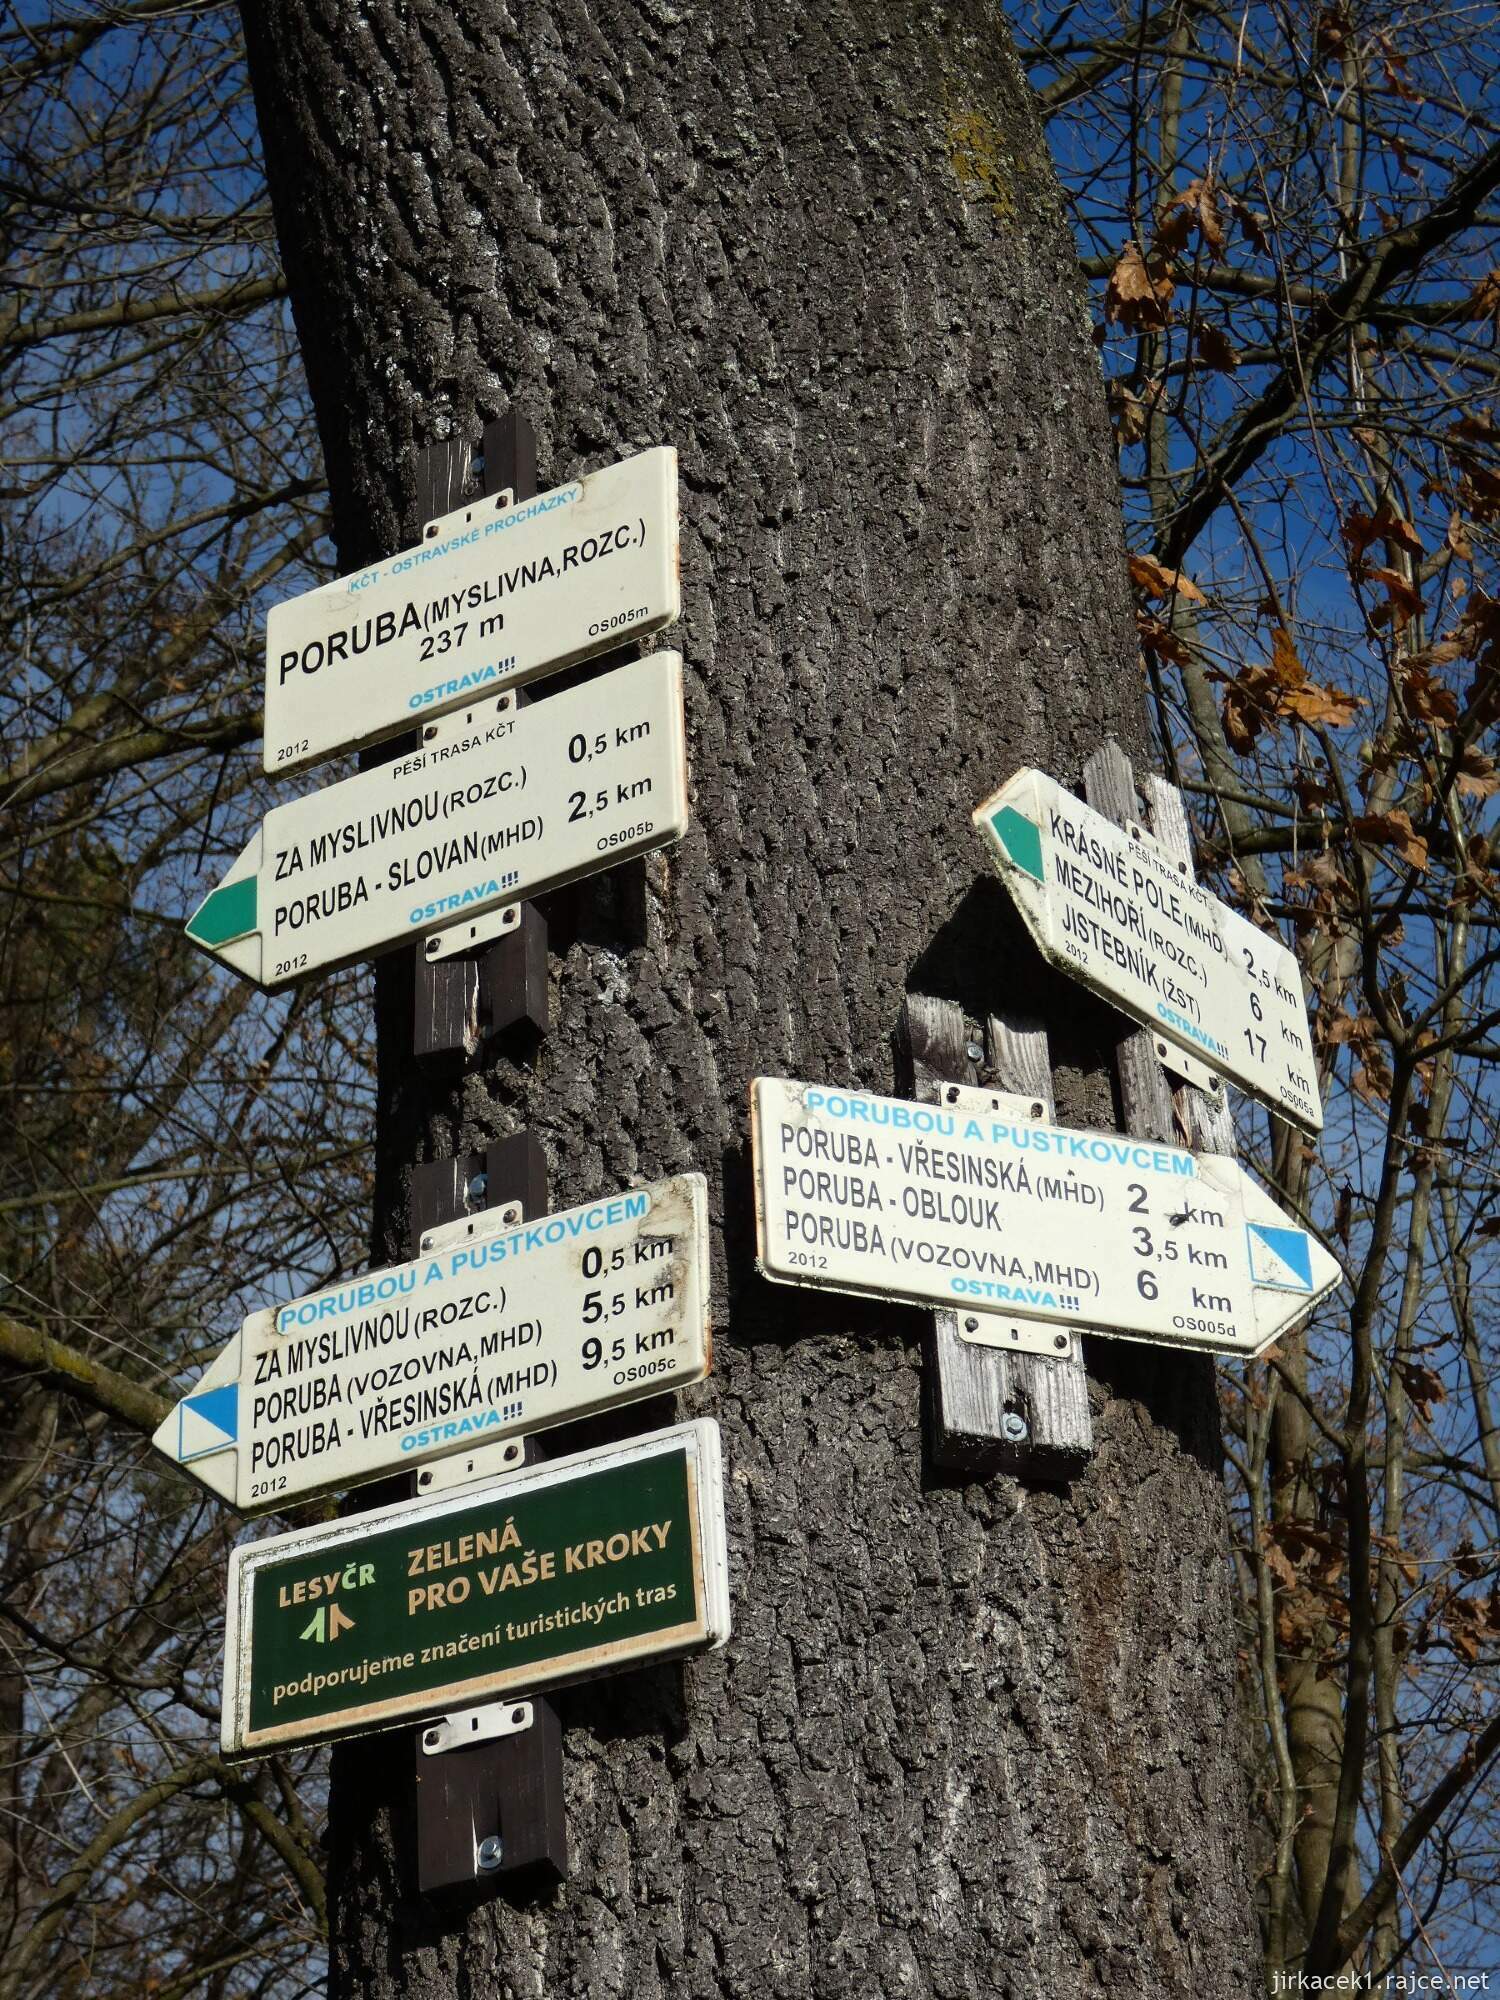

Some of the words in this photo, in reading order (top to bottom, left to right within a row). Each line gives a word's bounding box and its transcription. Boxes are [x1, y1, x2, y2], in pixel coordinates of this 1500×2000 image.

[350, 571, 379, 592] KČT
[392, 528, 480, 574] OSTRAVSKÉ
[485, 488, 577, 536] PROCHÁZKY
[420, 622, 468, 661] 237
[480, 613, 504, 638] m
[588, 607, 648, 636] OS005m
[277, 739, 309, 761] 2012
[393, 754, 427, 779] PĚŠÍ
[430, 736, 481, 764] TRASA
[486, 721, 516, 743] KČT
[275, 847, 304, 881] ZA
[568, 728, 608, 765] 0,5
[615, 720, 651, 743] km
[275, 876, 369, 936] PORUBA
[568, 790, 609, 823] 2,5
[617, 777, 653, 803] km
[597, 820, 654, 851] OS005b
[1153, 859, 1188, 894] TRASA
[1049, 809, 1129, 889] KRÁSNÉ
[1243, 948, 1271, 988] 2,5
[1274, 977, 1297, 1008] km
[276, 953, 308, 977] 2012
[1065, 940, 1089, 964] 2012
[1250, 992, 1263, 1021] 6
[1280, 1020, 1303, 1051] km
[1244, 1028, 1267, 1063] 17
[1287, 1063, 1310, 1095] km
[1280, 1085, 1314, 1117] OS005a
[807, 1091, 954, 1136] PORUBOU
[964, 1119, 984, 1141] A
[992, 1124, 1194, 1177] PUSTKOVCEM
[780, 1122, 880, 1169] PORUBA
[1127, 1183, 1150, 1215] 2
[1184, 1202, 1224, 1227] km
[783, 1166, 883, 1212] PORUBA
[902, 1186, 1003, 1231] OBLOUK
[1132, 1226, 1179, 1262] 3,5
[1188, 1243, 1228, 1269] km
[281, 1272, 416, 1332] PORUBOU
[423, 1262, 443, 1286] A
[452, 1194, 646, 1277] PUSTKOVCEM
[788, 1251, 828, 1269] 2012
[254, 1350, 282, 1385] ZA
[582, 1246, 625, 1279] 0,5
[635, 1239, 673, 1264] km
[582, 1291, 625, 1324] 5,5
[636, 1283, 674, 1309] km
[1137, 1269, 1159, 1300] 6
[1192, 1287, 1232, 1312] km
[1173, 1315, 1236, 1337] OS005d
[252, 1418, 341, 1474] PORUBA
[582, 1337, 625, 1371] 9,5
[636, 1328, 674, 1354] km
[614, 1359, 676, 1386] OS005c
[251, 1476, 287, 1497] 2012
[407, 1515, 522, 1576] ZELENÁ
[408, 1576, 471, 1616] PRO
[478, 1549, 556, 1596] VAŠE
[565, 1520, 672, 1573] KROKY
[273, 1652, 415, 1705] podporujeme
[421, 1624, 501, 1664] značení
[506, 1592, 630, 1641] turistických
[635, 1583, 677, 1607] tras
